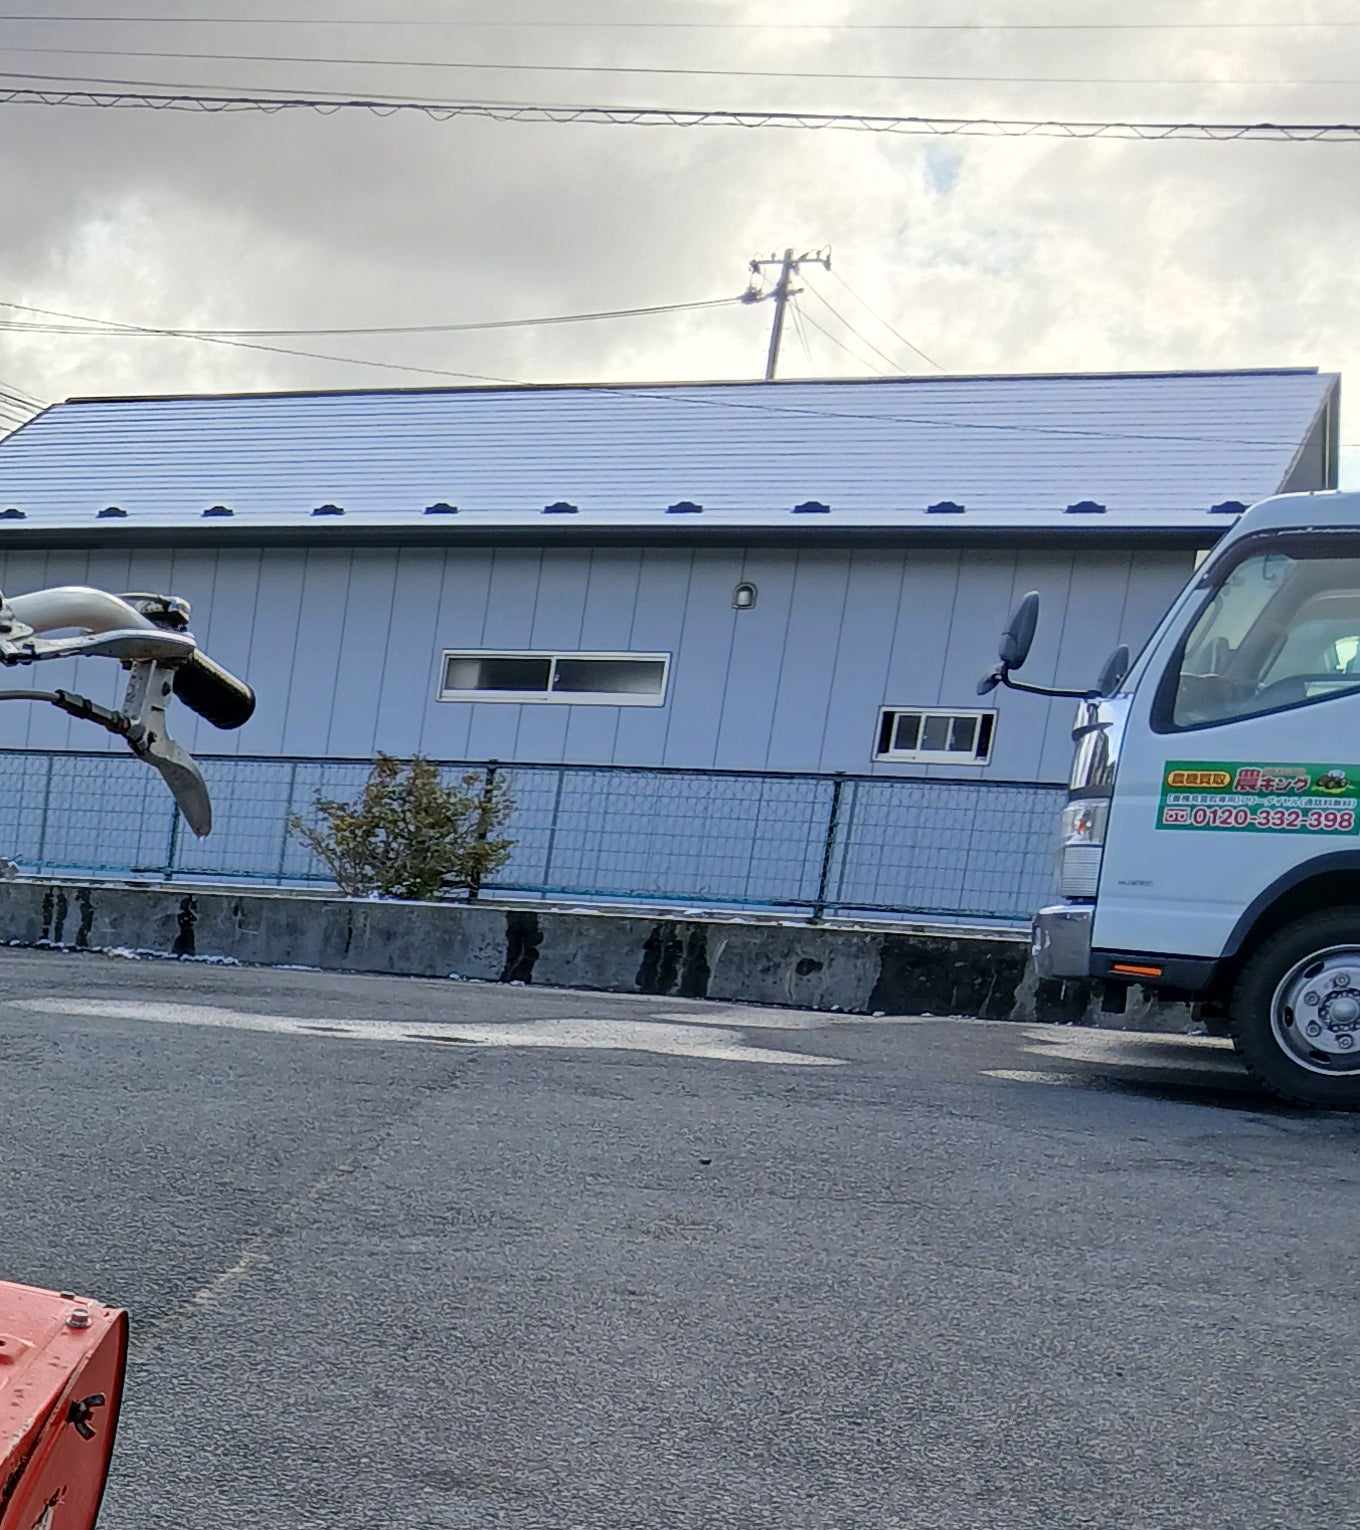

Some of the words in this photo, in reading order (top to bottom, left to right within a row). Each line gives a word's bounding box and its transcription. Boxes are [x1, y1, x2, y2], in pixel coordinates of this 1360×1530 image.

[1234, 768, 1310, 792] 農キング
[1192, 808, 1353, 830] 0120-332-398
